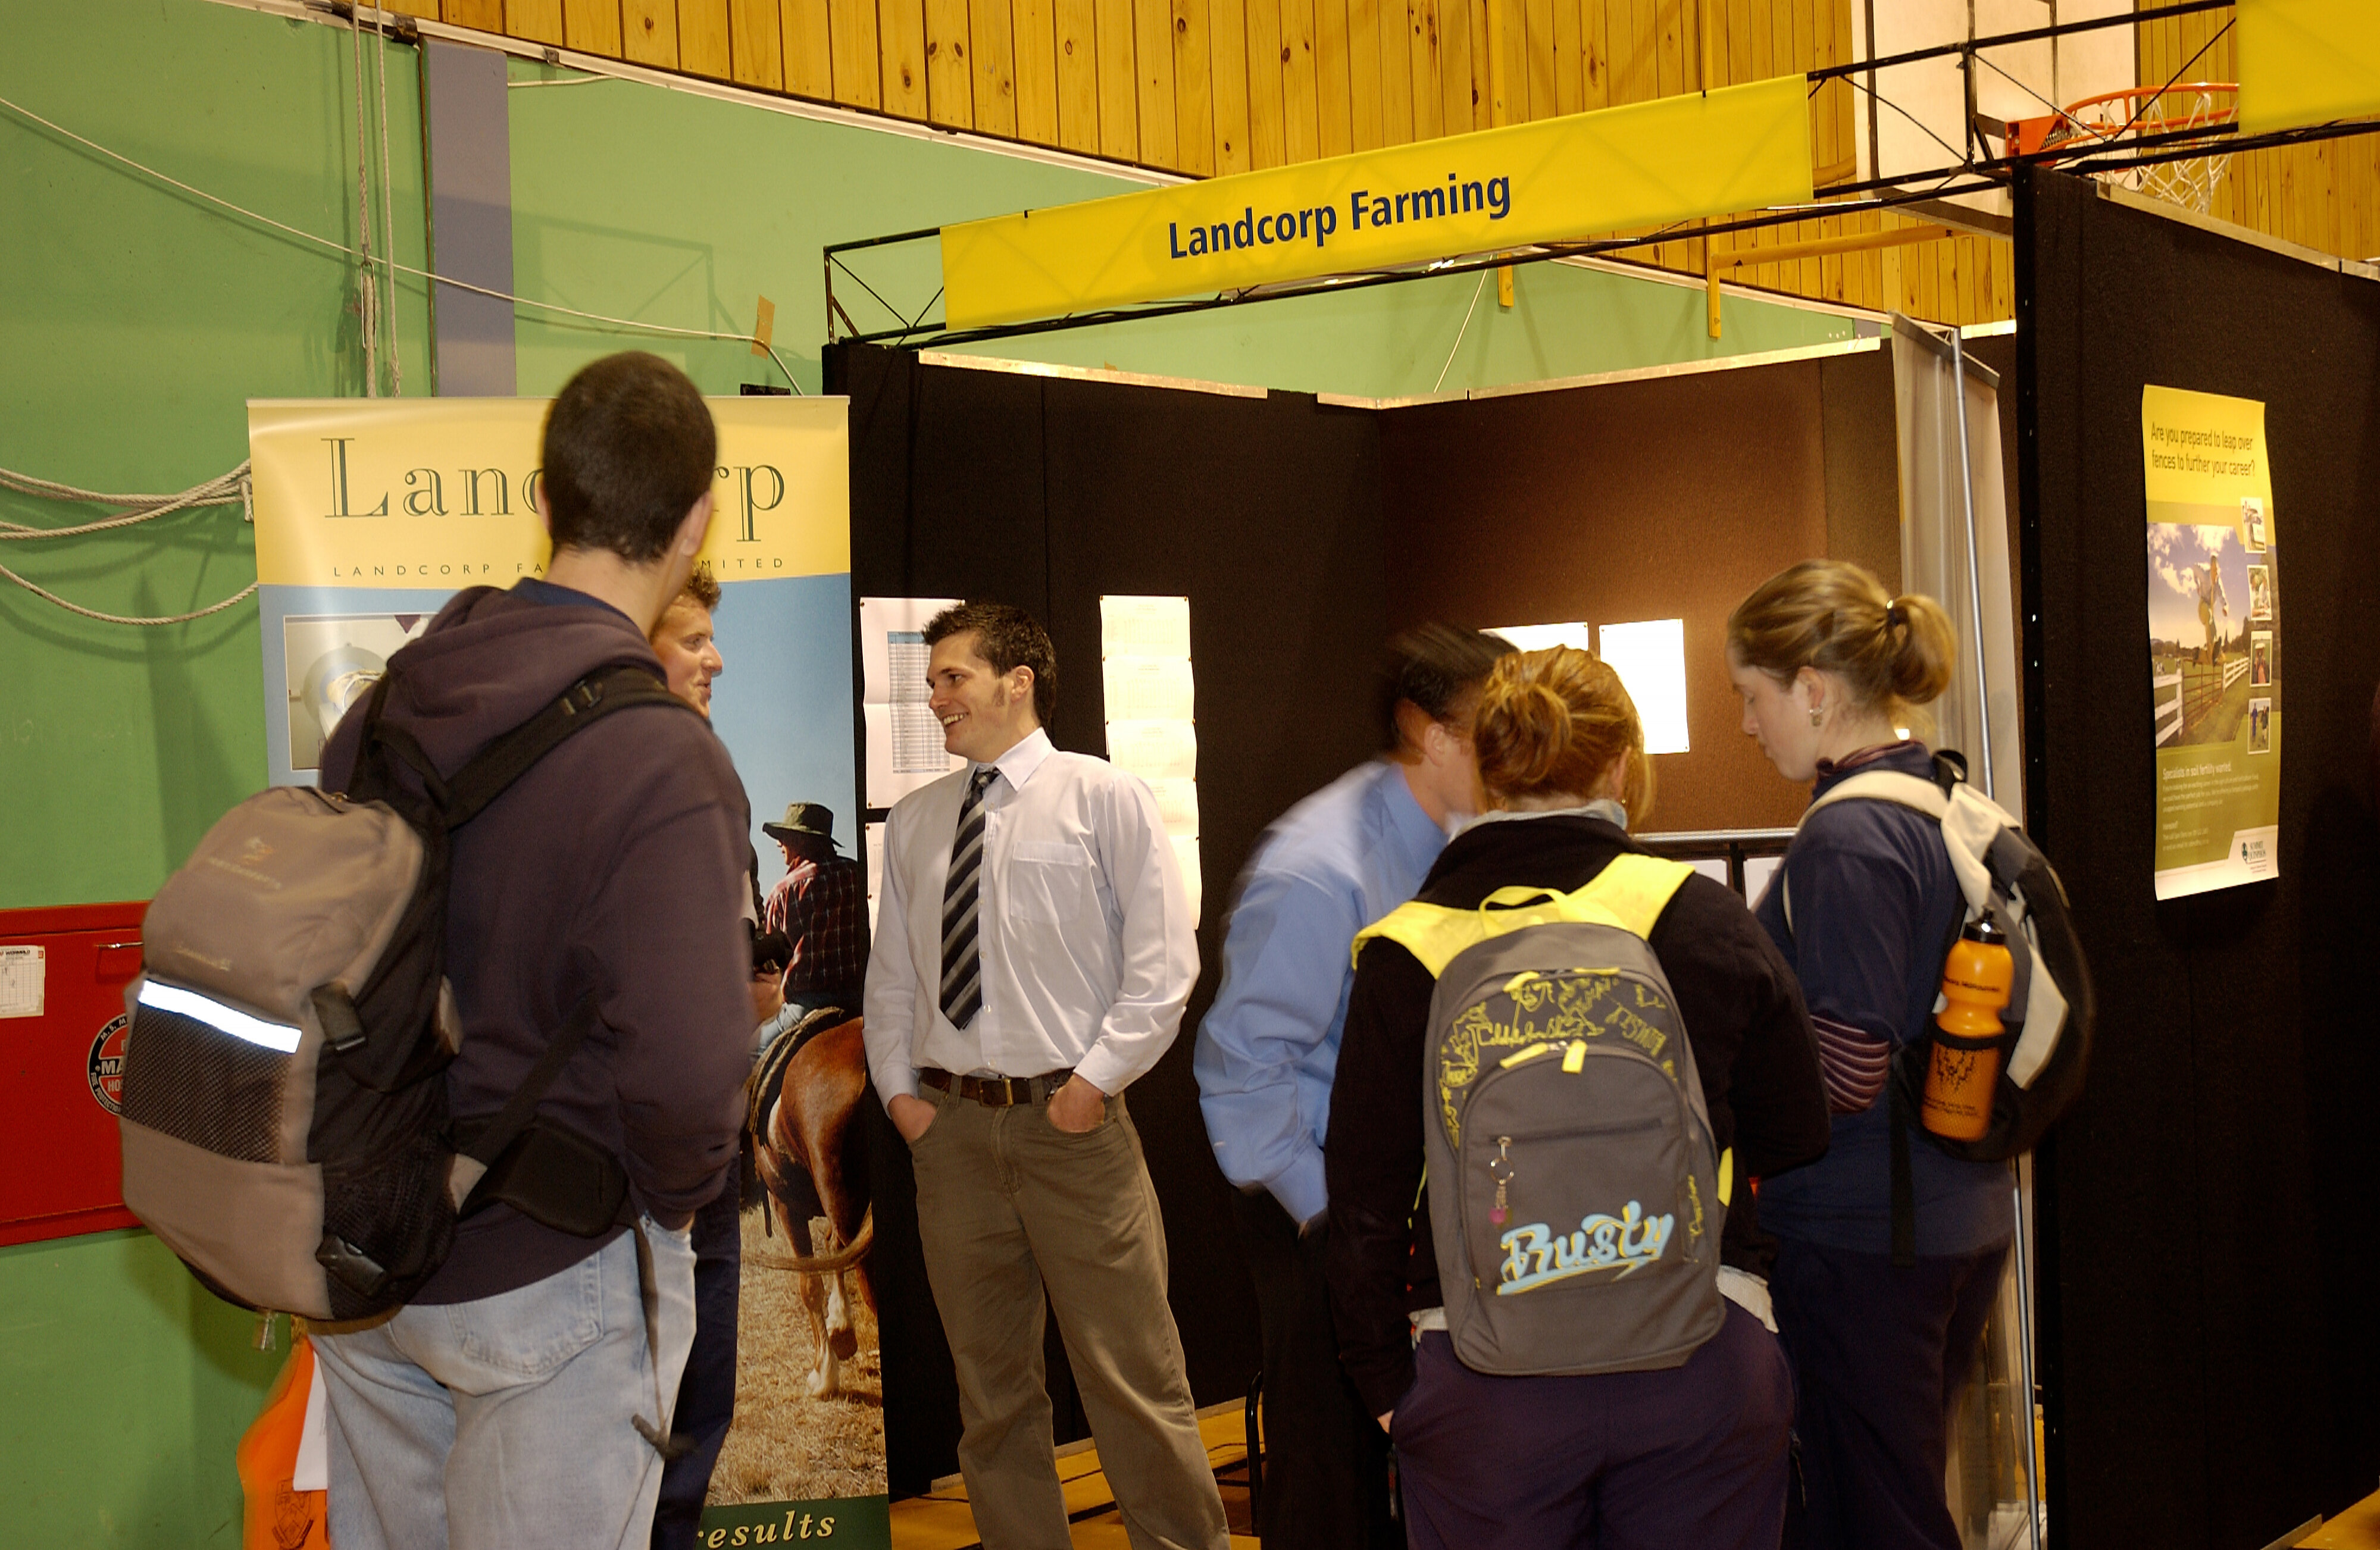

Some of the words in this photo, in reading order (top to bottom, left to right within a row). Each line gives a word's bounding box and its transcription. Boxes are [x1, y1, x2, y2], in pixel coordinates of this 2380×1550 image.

[1169, 205, 1337, 259] Landcorp
[1351, 173, 1511, 230] Farming
[2151, 421, 2163, 441] Are
[2165, 428, 2179, 446] you
[2181, 428, 2212, 449] prepared
[2214, 431, 2221, 447] to
[2222, 431, 2236, 455] leap
[2238, 437, 2253, 450] over
[2152, 449, 2176, 469] fences
[2177, 453, 2184, 471] to
[2185, 453, 2210, 472] further
[2212, 462, 2227, 478] your
[2229, 459, 2255, 477] career?
[334, 564, 490, 577] LANDCORP
[1496, 1200, 1674, 1295] Rusty
